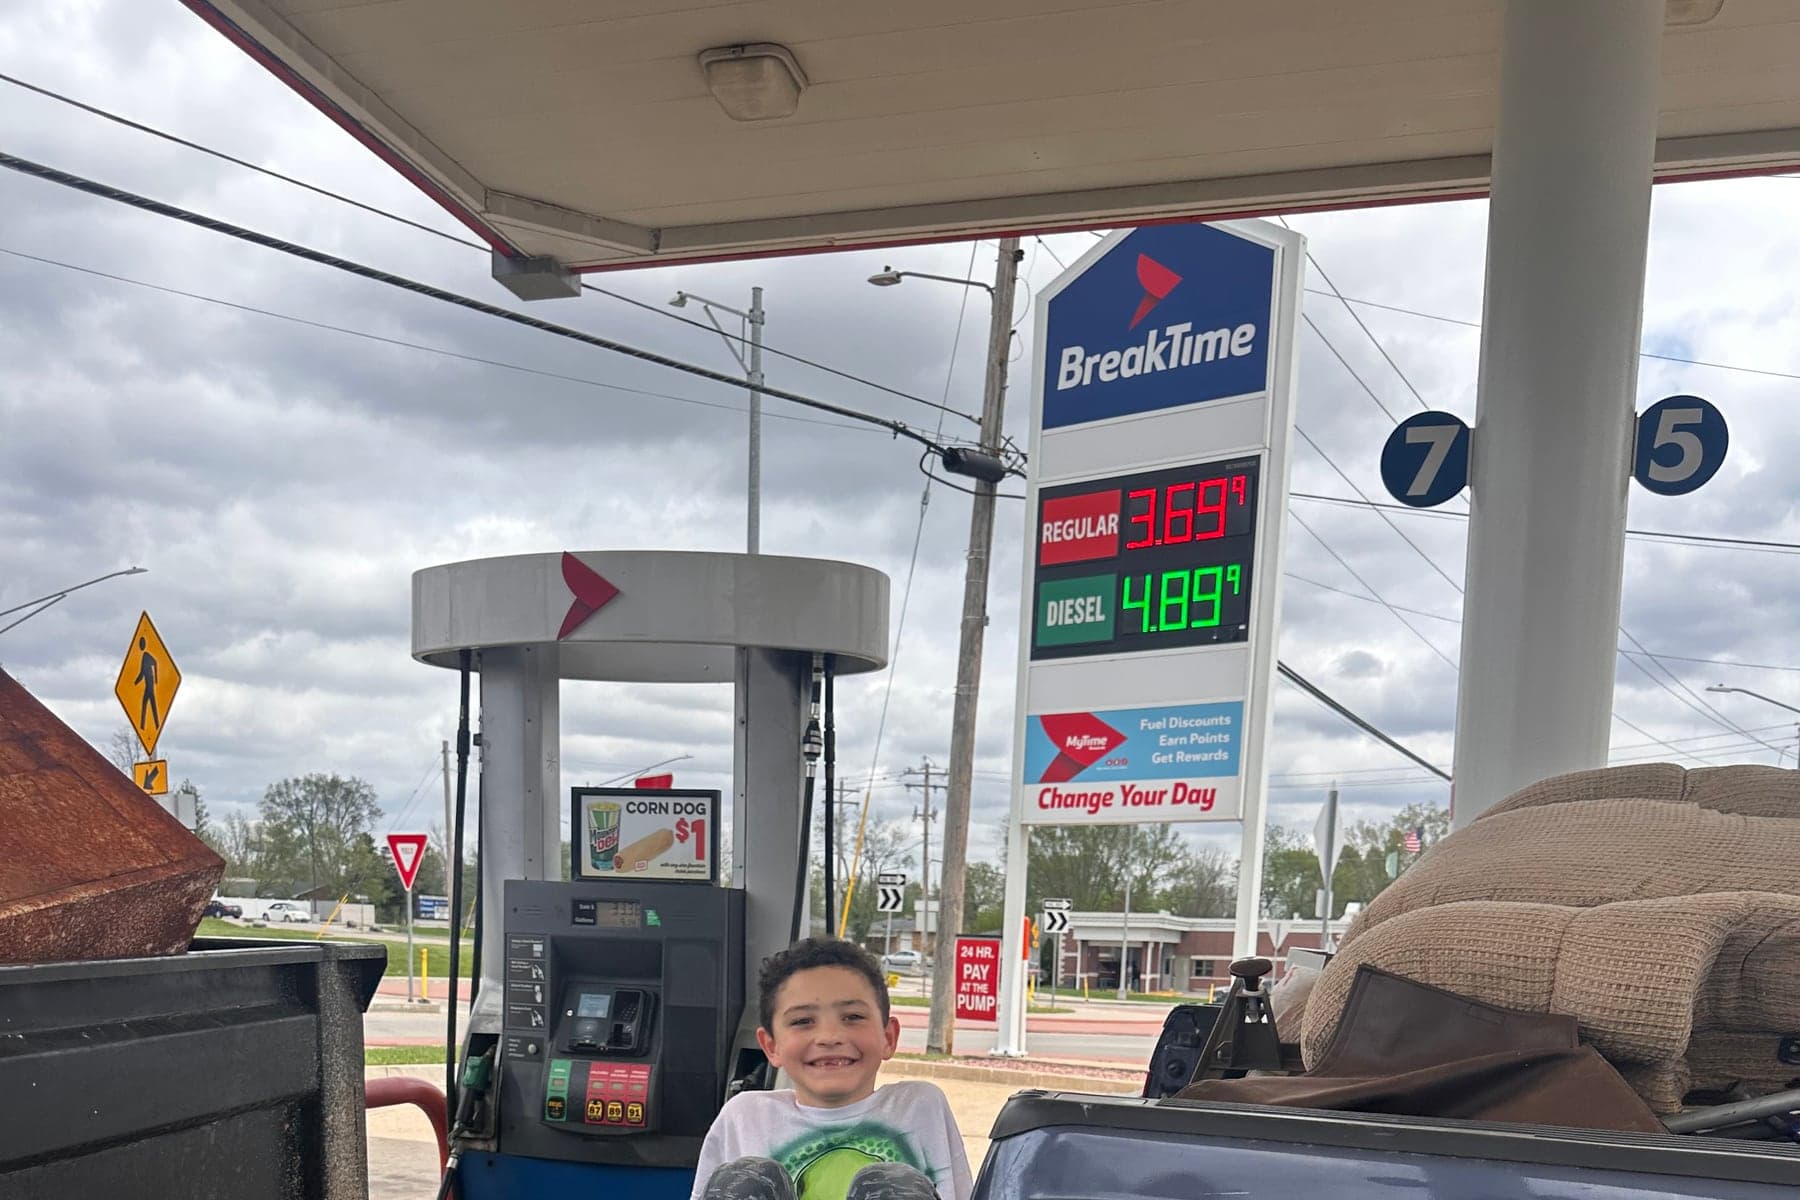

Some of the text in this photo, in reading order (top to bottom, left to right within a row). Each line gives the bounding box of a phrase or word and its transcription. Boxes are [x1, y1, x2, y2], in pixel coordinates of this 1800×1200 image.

[1056, 322, 1256, 391] BreakTime
[1648, 408, 1704, 482] 5
[1405, 424, 1461, 497] 7
[1042, 513, 1119, 544] REGULAR
[1046, 596, 1105, 627] DIESEL
[1140, 715, 1231, 731] Fuel Discounts
[1066, 736, 1107, 749] MyTime
[1159, 733, 1230, 747] Earn Points
[1152, 750, 1229, 765] Get Rewards
[1038, 782, 1217, 815] Change Your Day
[626, 801, 707, 816] CORN DOG
[675, 817, 706, 861] $1
[960, 946, 994, 958] 24 HR.
[963, 964, 989, 980] PAY
[960, 982, 989, 994] AT THE
[957, 994, 995, 1011] PUMP
[589, 1106, 601, 1115] 87
[609, 1108, 621, 1116] 89
[629, 1109, 641, 1117] 91
